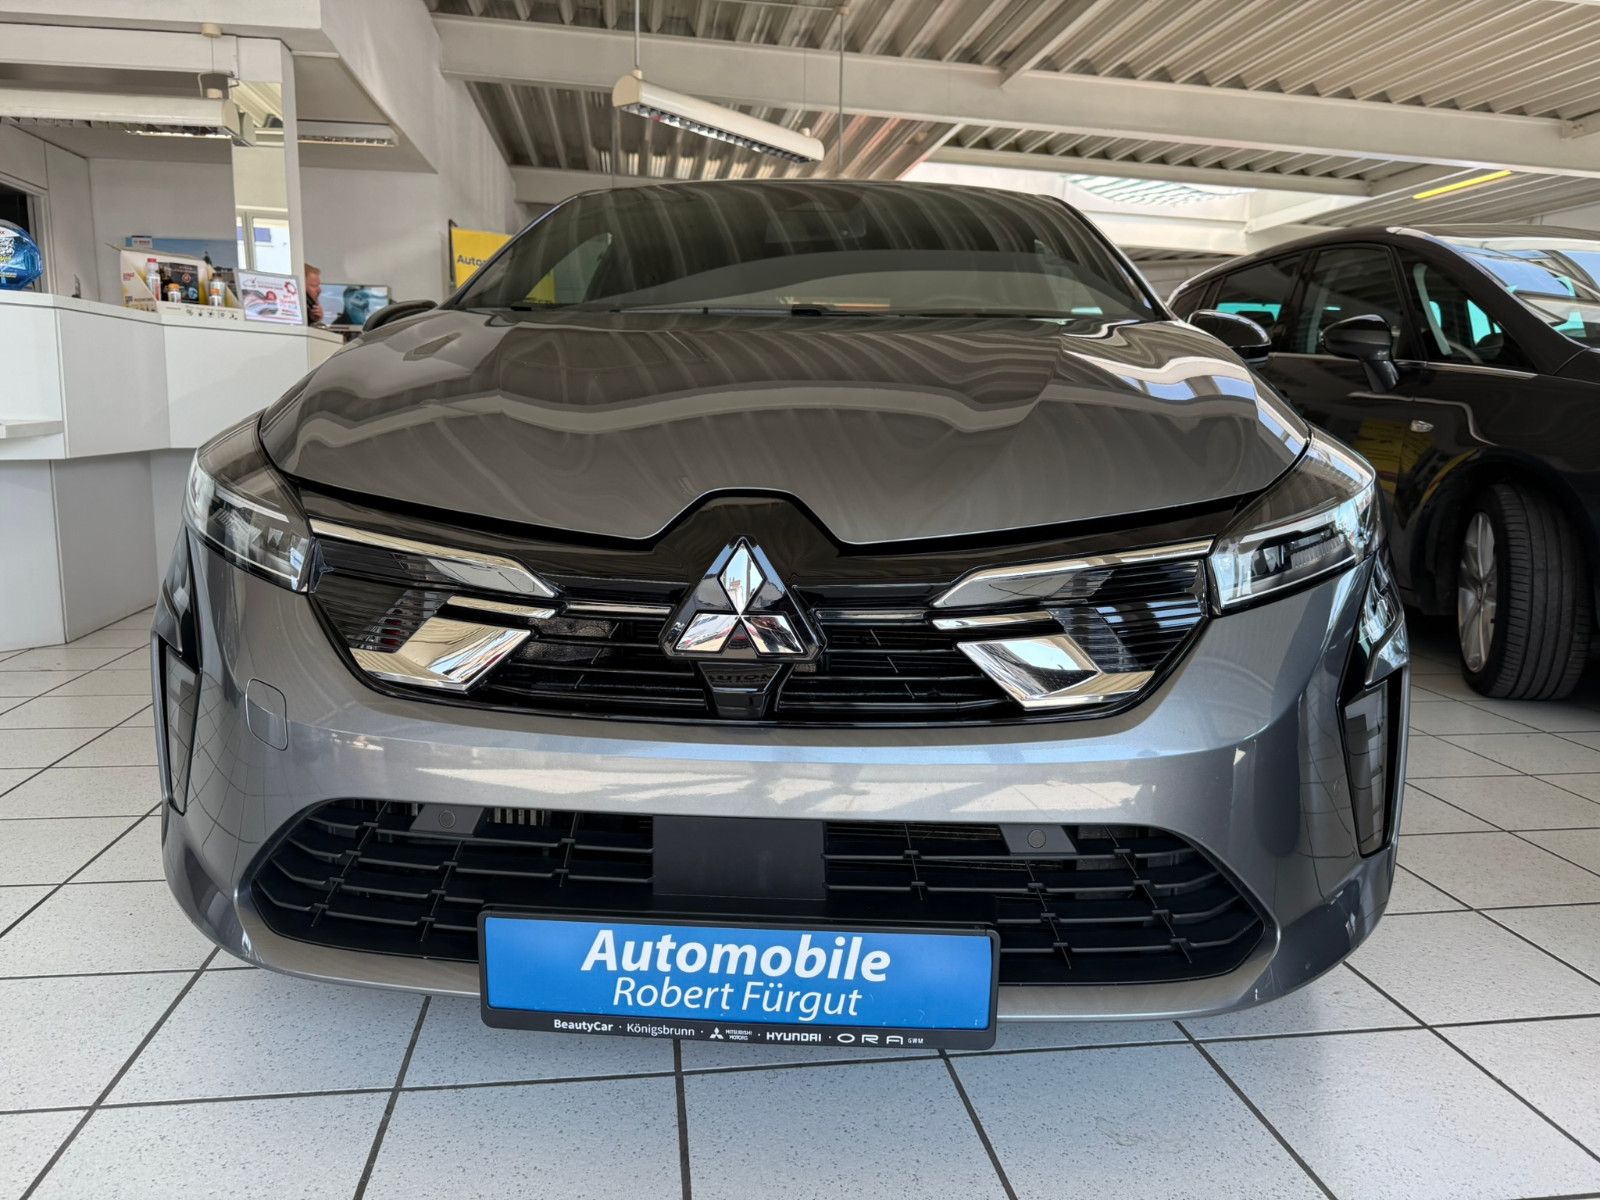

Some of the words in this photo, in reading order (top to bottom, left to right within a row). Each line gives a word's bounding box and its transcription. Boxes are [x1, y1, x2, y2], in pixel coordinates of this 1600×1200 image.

[581, 929, 891, 982] Automobile
[613, 976, 734, 1010] Robert
[742, 980, 862, 1022] Fürgut
[553, 1018, 614, 1033] BeautyCar
[626, 1022, 695, 1037] Königsbrunn
[766, 1031, 822, 1042] HYUNDAI
